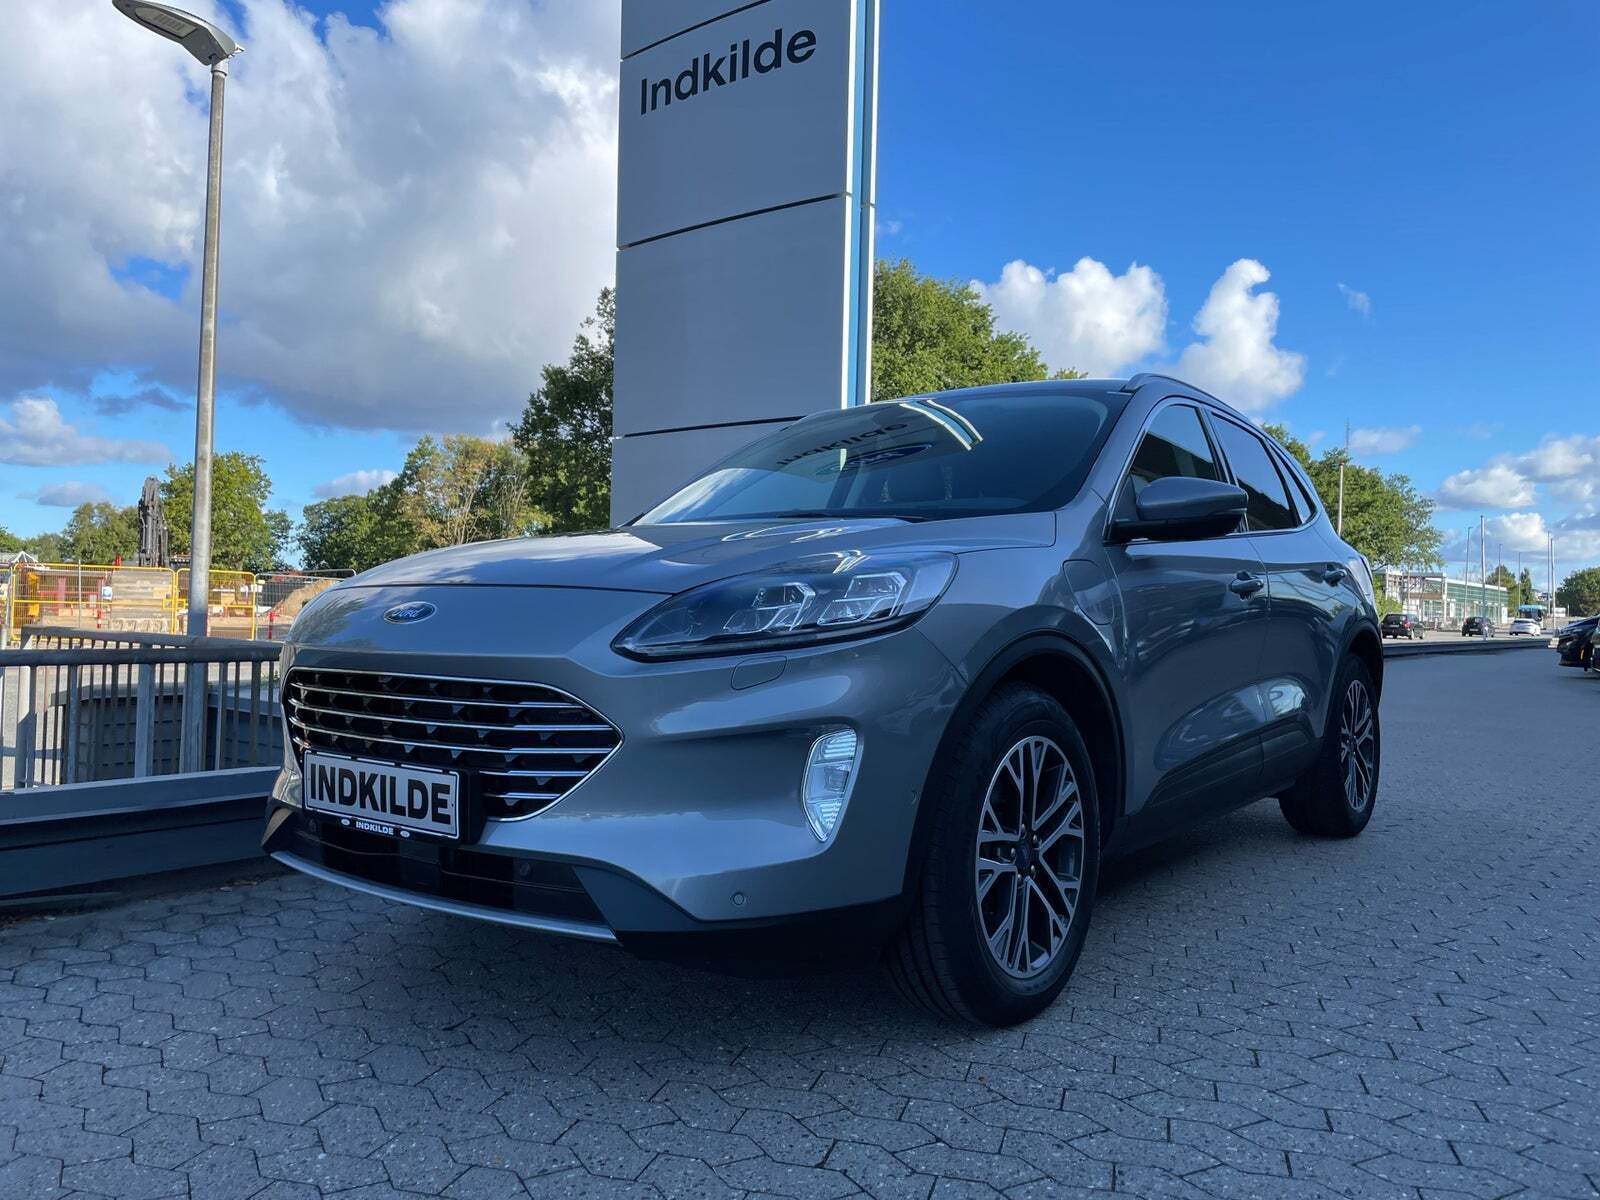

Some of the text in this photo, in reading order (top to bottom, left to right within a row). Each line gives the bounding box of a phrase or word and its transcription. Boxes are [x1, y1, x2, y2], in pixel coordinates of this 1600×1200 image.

[640, 28, 817, 115] Indkilde
[310, 763, 451, 825] INDKILDE
[355, 821, 394, 836] INDKILDE
